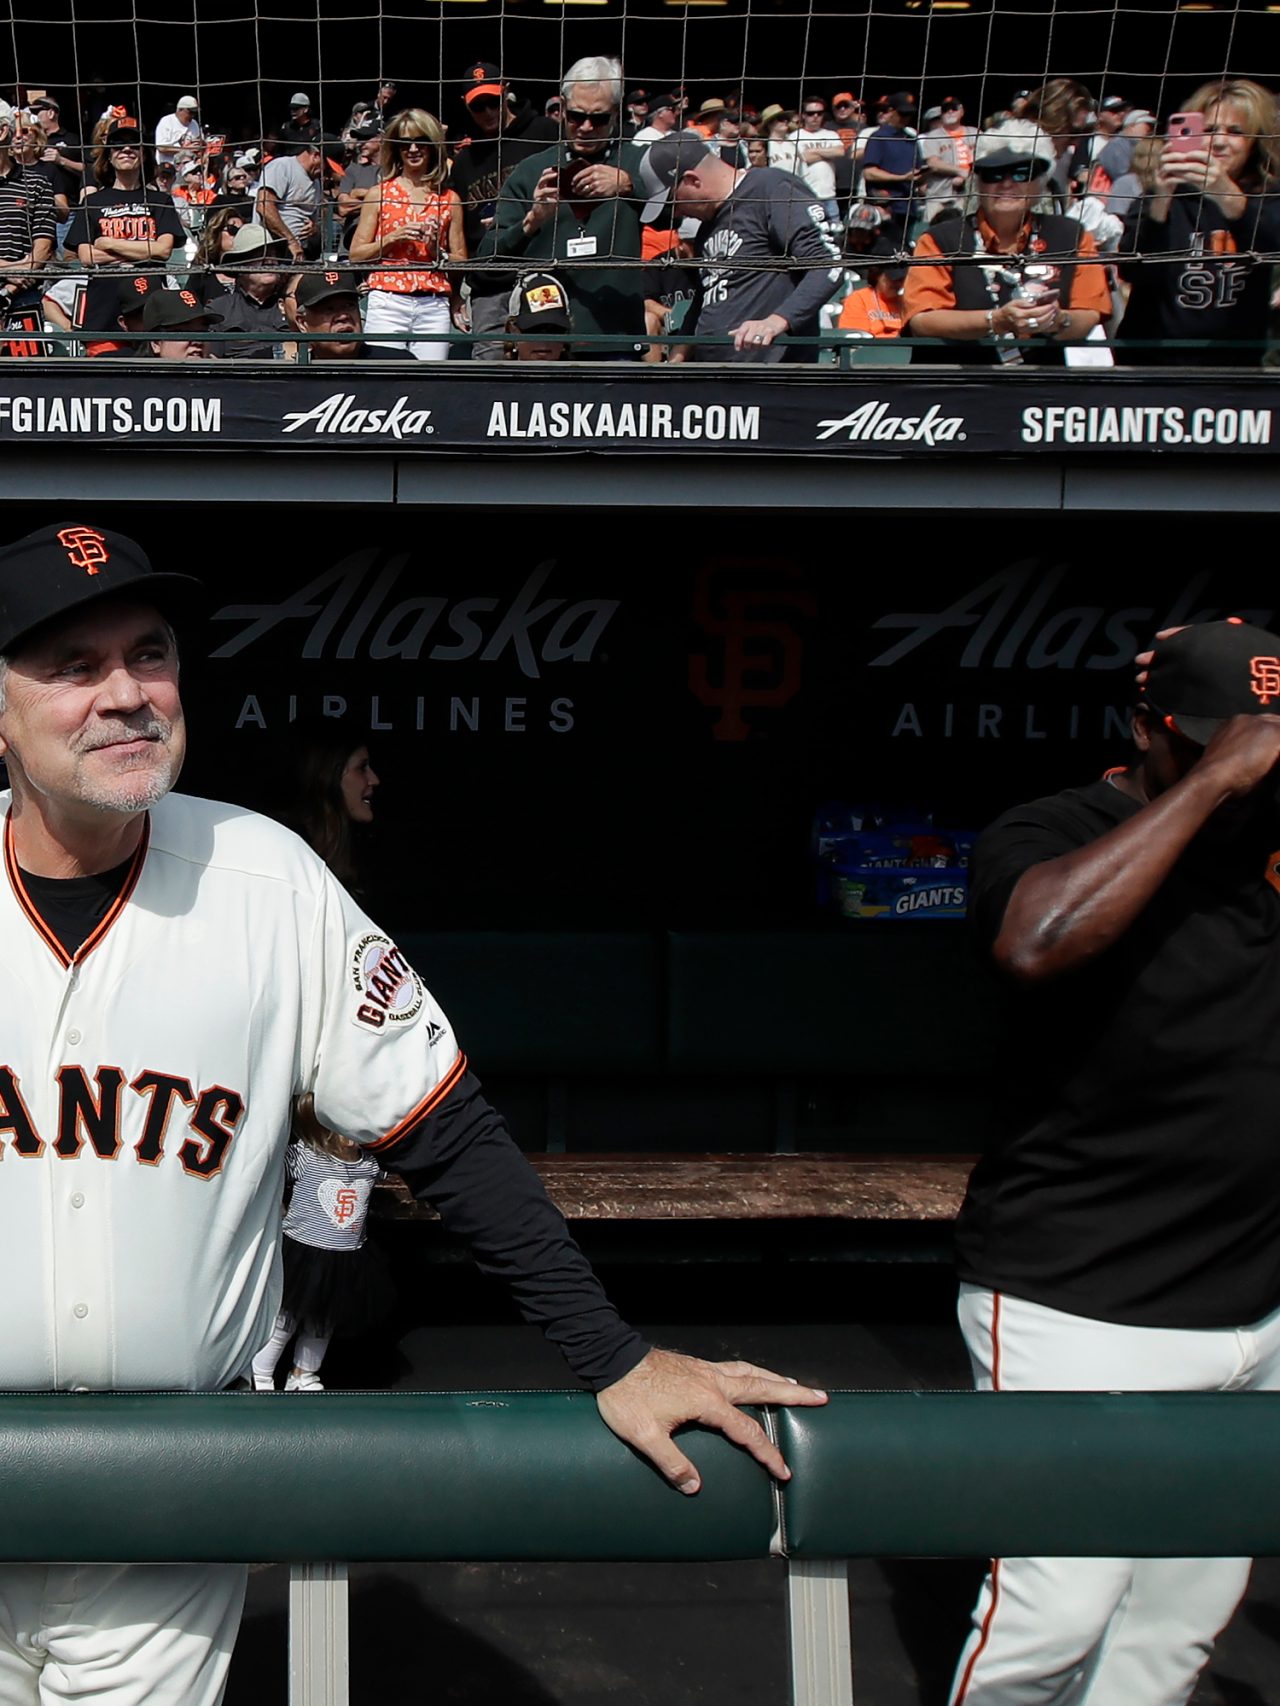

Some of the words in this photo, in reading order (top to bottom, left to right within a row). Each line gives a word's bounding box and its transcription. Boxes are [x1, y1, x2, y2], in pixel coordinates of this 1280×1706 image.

[99, 216, 158, 240] BRUCE
[1177, 268, 1252, 309] SF
[282, 393, 431, 440] Alaska
[487, 402, 760, 439] ALASKAAIR.COM
[816, 401, 964, 447] Alaska
[1022, 407, 1272, 443] SFGIANTS.COM
[56, 526, 110, 576] SF
[207, 546, 622, 679] Alaska
[892, 702, 1133, 741] AIRLIN
[896, 887, 965, 914] GIANTS
[356, 946, 410, 1029] GIANT
